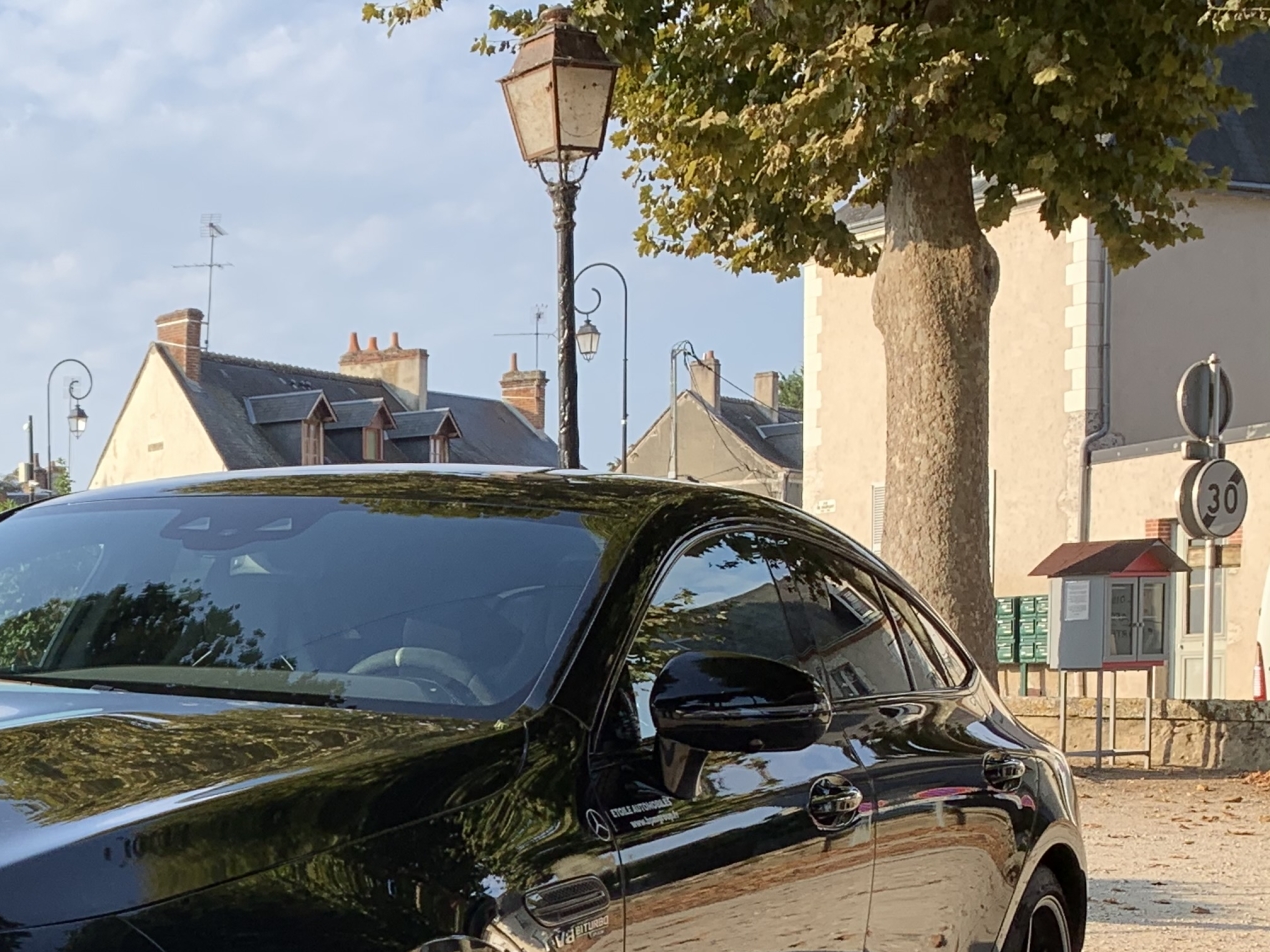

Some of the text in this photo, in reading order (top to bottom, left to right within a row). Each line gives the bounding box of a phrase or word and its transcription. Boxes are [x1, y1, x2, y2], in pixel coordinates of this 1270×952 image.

[1207, 483, 1238, 514] 30
[609, 805, 634, 819] ETOILE
[575, 915, 609, 936] BITURBO
